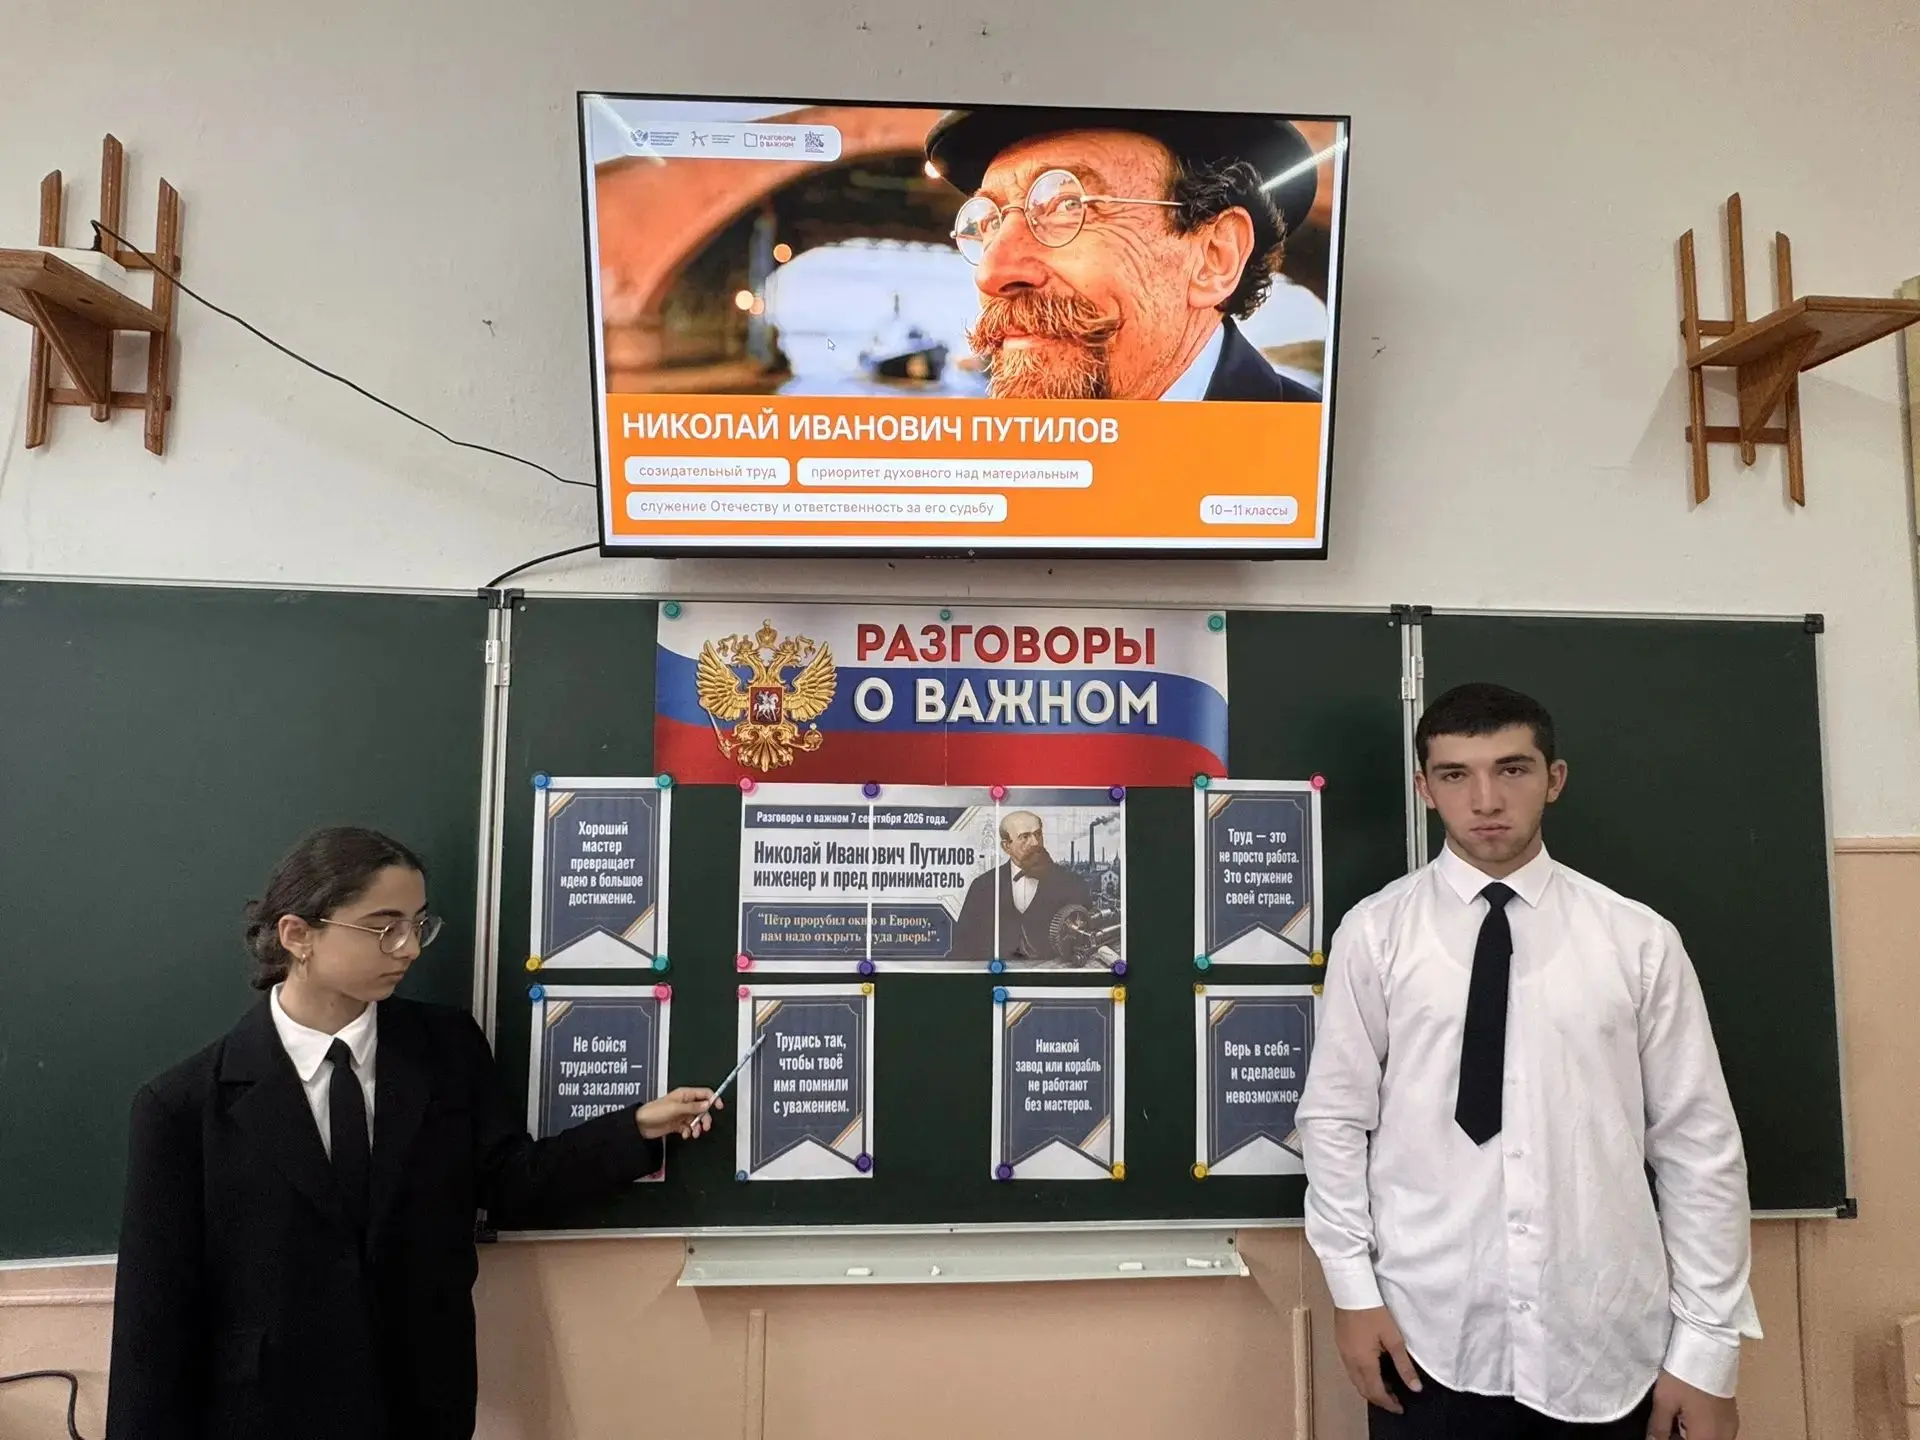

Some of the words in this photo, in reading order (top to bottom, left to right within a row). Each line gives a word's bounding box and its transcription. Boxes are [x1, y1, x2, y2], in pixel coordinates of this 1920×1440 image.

[622, 407, 779, 440] НИКОЛАЙ
[789, 414, 962, 441] ИВАНОВИЧ
[972, 416, 1119, 443] ПУТИЛОВ
[639, 465, 743, 479] созидательный
[746, 467, 777, 480] труд
[811, 468, 881, 481] приоритет
[884, 468, 951, 481] духовного
[955, 469, 979, 481] над
[982, 470, 1079, 482] материальным
[640, 502, 707, 515] служение
[710, 501, 778, 515] Отечеству
[783, 503, 790, 512] и
[794, 503, 903, 513] ответственность
[906, 503, 921, 513] за
[925, 503, 946, 514] его
[950, 502, 994, 516] судьбу
[1245, 507, 1288, 516] классы
[857, 623, 1156, 665] РАЗГОВОРЫ
[855, 677, 895, 724] О
[915, 678, 1160, 726] ВАЖНОМ
[757, 811, 804, 824] Разговоры
[806, 814, 812, 823] о
[814, 814, 849, 823] важном
[851, 813, 856, 823] 7
[858, 813, 901, 825] сентября
[903, 813, 924, 824] 2026
[926, 815, 948, 825] года.
[578, 821, 628, 838] Хороший
[1228, 828, 1253, 846] Труд
[1269, 831, 1287, 843] это
[582, 841, 622, 855] мастер
[754, 841, 821, 864] Николай
[826, 841, 905, 865] Иванович
[910, 842, 974, 869] Путилов
[570, 857, 635, 872] превращает
[1219, 851, 1230, 862] не
[1232, 851, 1263, 865] просто
[1266, 849, 1299, 866] работа.
[560, 874, 588, 888] идею
[591, 874, 597, 886] в
[599, 872, 643, 887] большое
[753, 870, 816, 891] инженер
[820, 871, 829, 887] и
[1224, 868, 1241, 883] Это
[1244, 870, 1293, 886] служение
[568, 892, 636, 906] достижение.
[1226, 890, 1255, 904] своей
[1258, 892, 1295, 907] стране.
[794, 914, 845, 928] прорубил
[848, 916, 877, 926] окно
[880, 917, 887, 926] в
[889, 914, 932, 928] Европу,
[760, 932, 782, 942] нам
[785, 933, 811, 943] надо
[814, 933, 861, 944] открыть
[573, 1036, 588, 1052] Не
[591, 1036, 627, 1052] бойся
[775, 1032, 821, 1052] Трудись
[824, 1034, 846, 1049] так,
[1036, 1038, 1079, 1053] Никакой
[1224, 1040, 1251, 1060] Верь
[1254, 1044, 1261, 1056] в
[1264, 1040, 1290, 1056] себя
[560, 1057, 628, 1077] трудностей
[779, 1054, 815, 1070] чтобы
[817, 1053, 843, 1070] твоё
[1015, 1060, 1043, 1074] завод
[1045, 1061, 1062, 1072] или
[1065, 1057, 1101, 1075] корабль
[1231, 1067, 1238, 1080] и
[1241, 1066, 1296, 1082] сделаешь
[558, 1082, 580, 1095] они
[582, 1082, 641, 1095] закаляют
[773, 1079, 796, 1092] имя
[799, 1078, 849, 1092] помнили
[1028, 1079, 1040, 1091] не
[1042, 1077, 1088, 1094] работают
[773, 1100, 780, 1113] с
[782, 1099, 850, 1117] уважением.
[1024, 1097, 1041, 1111] без
[1044, 1099, 1093, 1114] мастеров.
